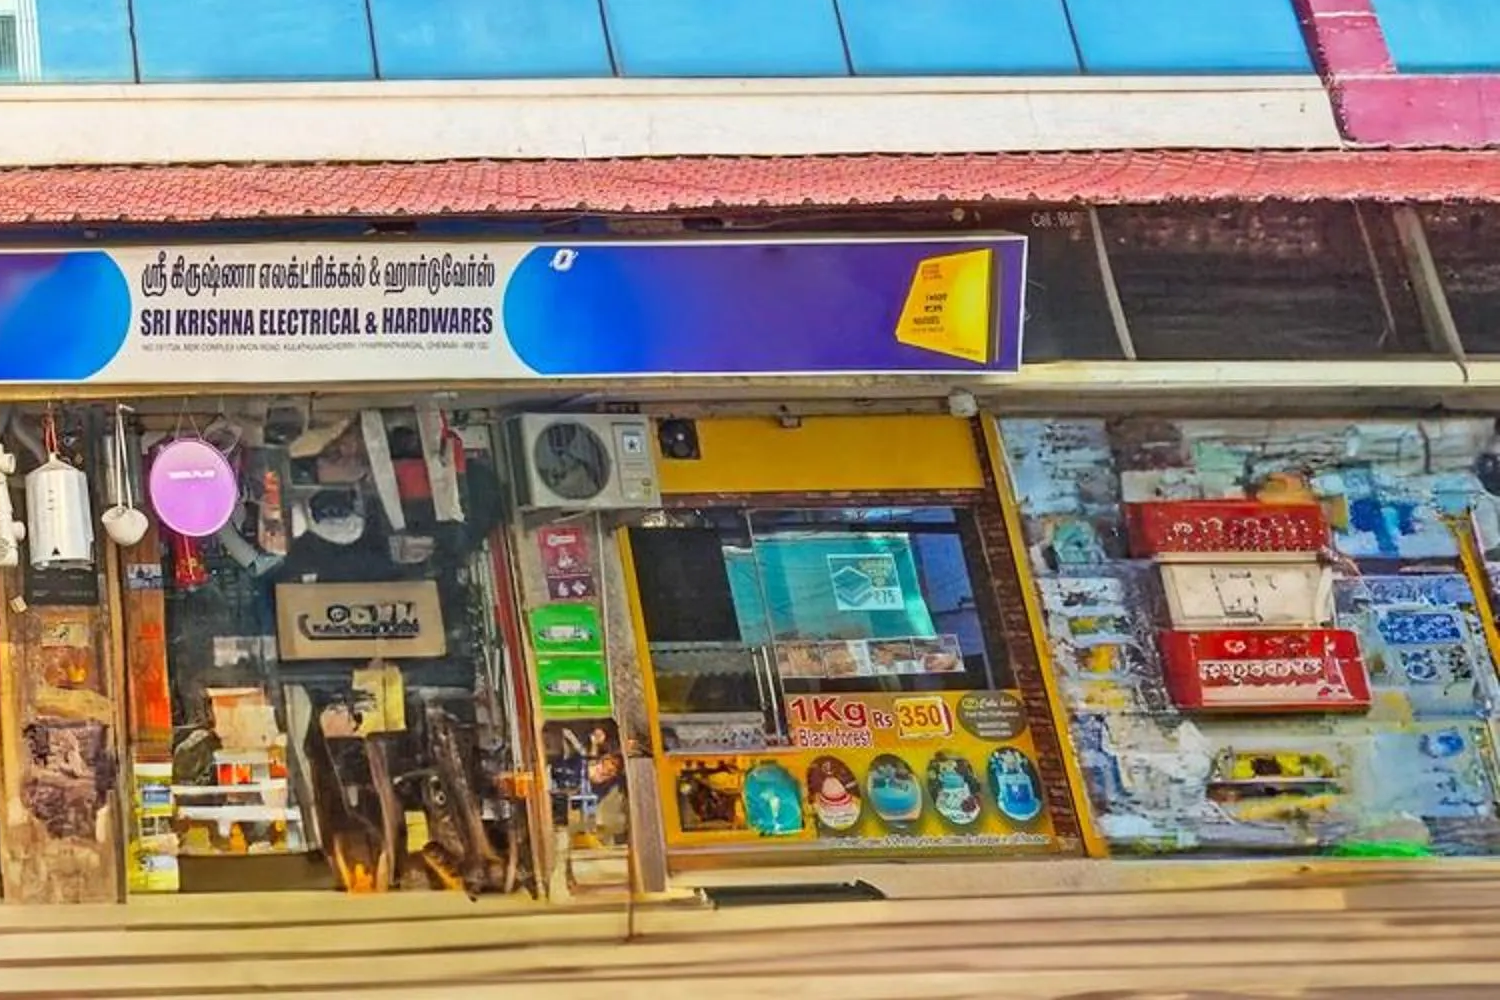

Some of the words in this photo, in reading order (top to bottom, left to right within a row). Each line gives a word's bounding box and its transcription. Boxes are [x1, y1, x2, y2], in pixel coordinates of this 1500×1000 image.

[141, 250, 168, 297] ஸ்ரீ
[171, 254, 256, 297] கிருஷ்ணா
[259, 253, 366, 290] எலக்ட்ரிக்கல்
[369, 255, 381, 287] &
[384, 253, 496, 297] ஹார்டுவேர்ஸ்
[141, 308, 171, 336] SRI
[174, 308, 256, 336] KRISHNA
[258, 308, 361, 336] ELECTRICAL
[365, 311, 378, 335] &
[382, 307, 493, 335] HARDWARES
[791, 697, 867, 728] 1Kg
[872, 710, 893, 729] Rs
[898, 704, 942, 727] 350
